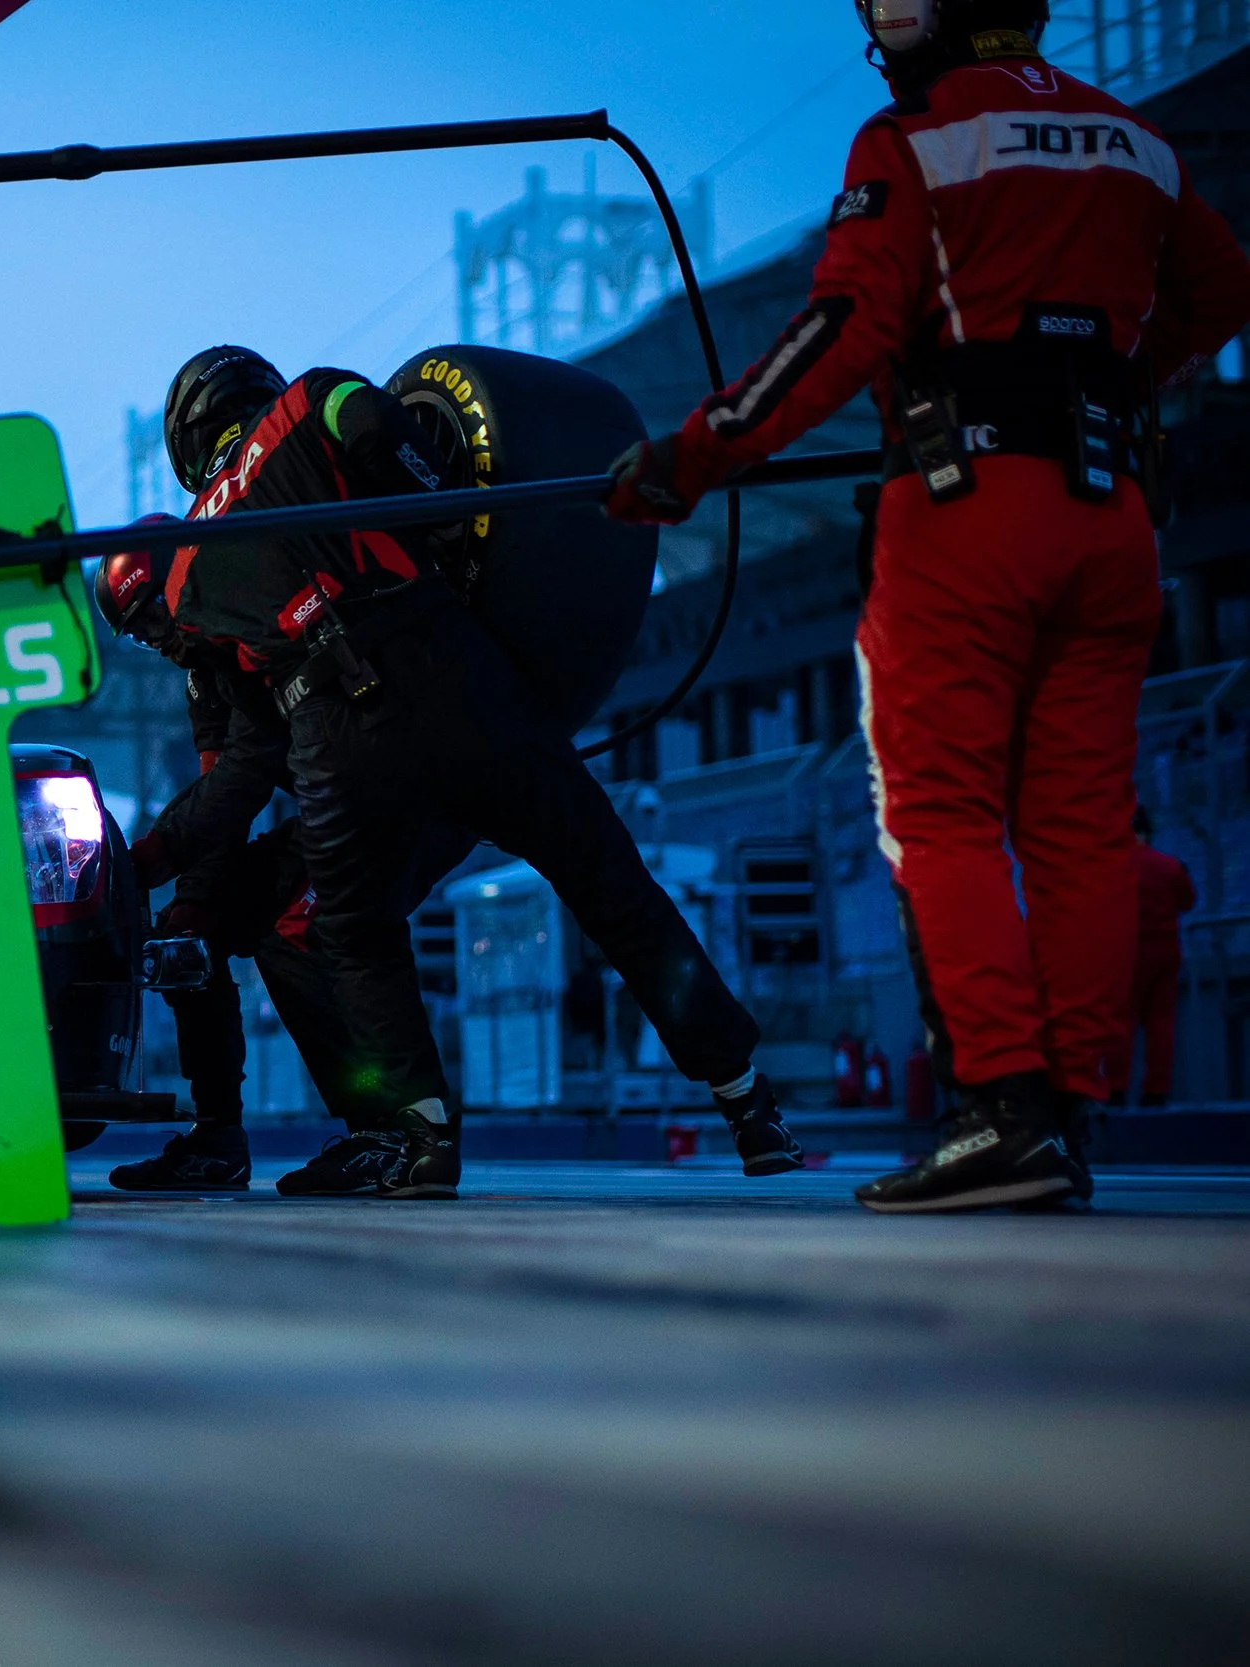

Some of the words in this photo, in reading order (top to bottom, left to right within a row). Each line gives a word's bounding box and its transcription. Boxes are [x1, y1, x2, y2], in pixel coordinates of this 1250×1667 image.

[997, 123, 1137, 158] JOTA
[1038, 314, 1096, 335] sparco
[117, 567, 145, 597] JOTA
[292, 585, 331, 623] spar
